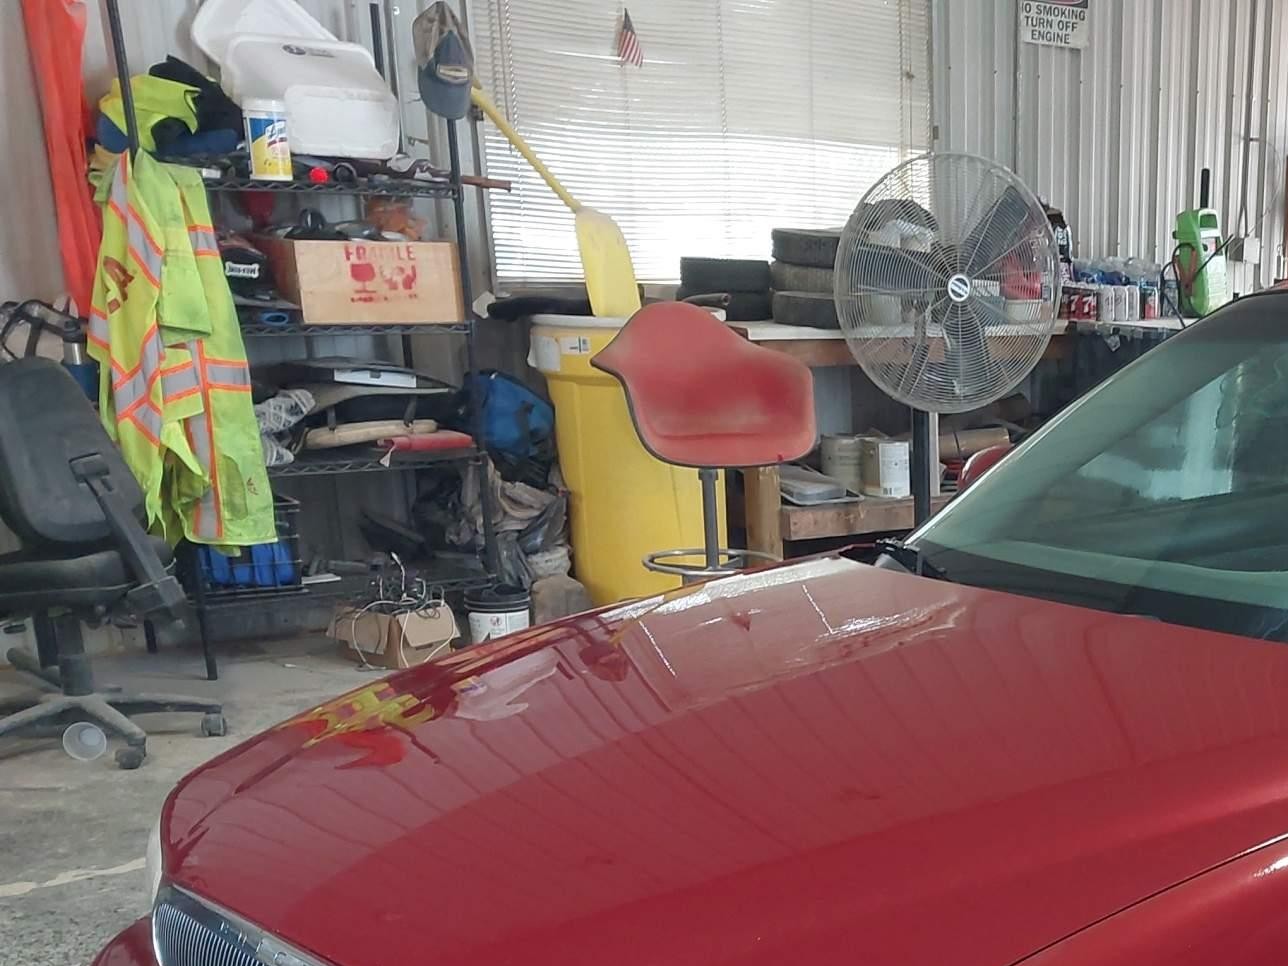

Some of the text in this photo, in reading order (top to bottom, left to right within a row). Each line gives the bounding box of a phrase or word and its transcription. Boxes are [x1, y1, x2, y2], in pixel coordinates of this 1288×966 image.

[1035, 4, 1086, 21] SMOKING
[1025, 15, 1078, 32] TURN OFF
[1031, 29, 1071, 44] ENGINE
